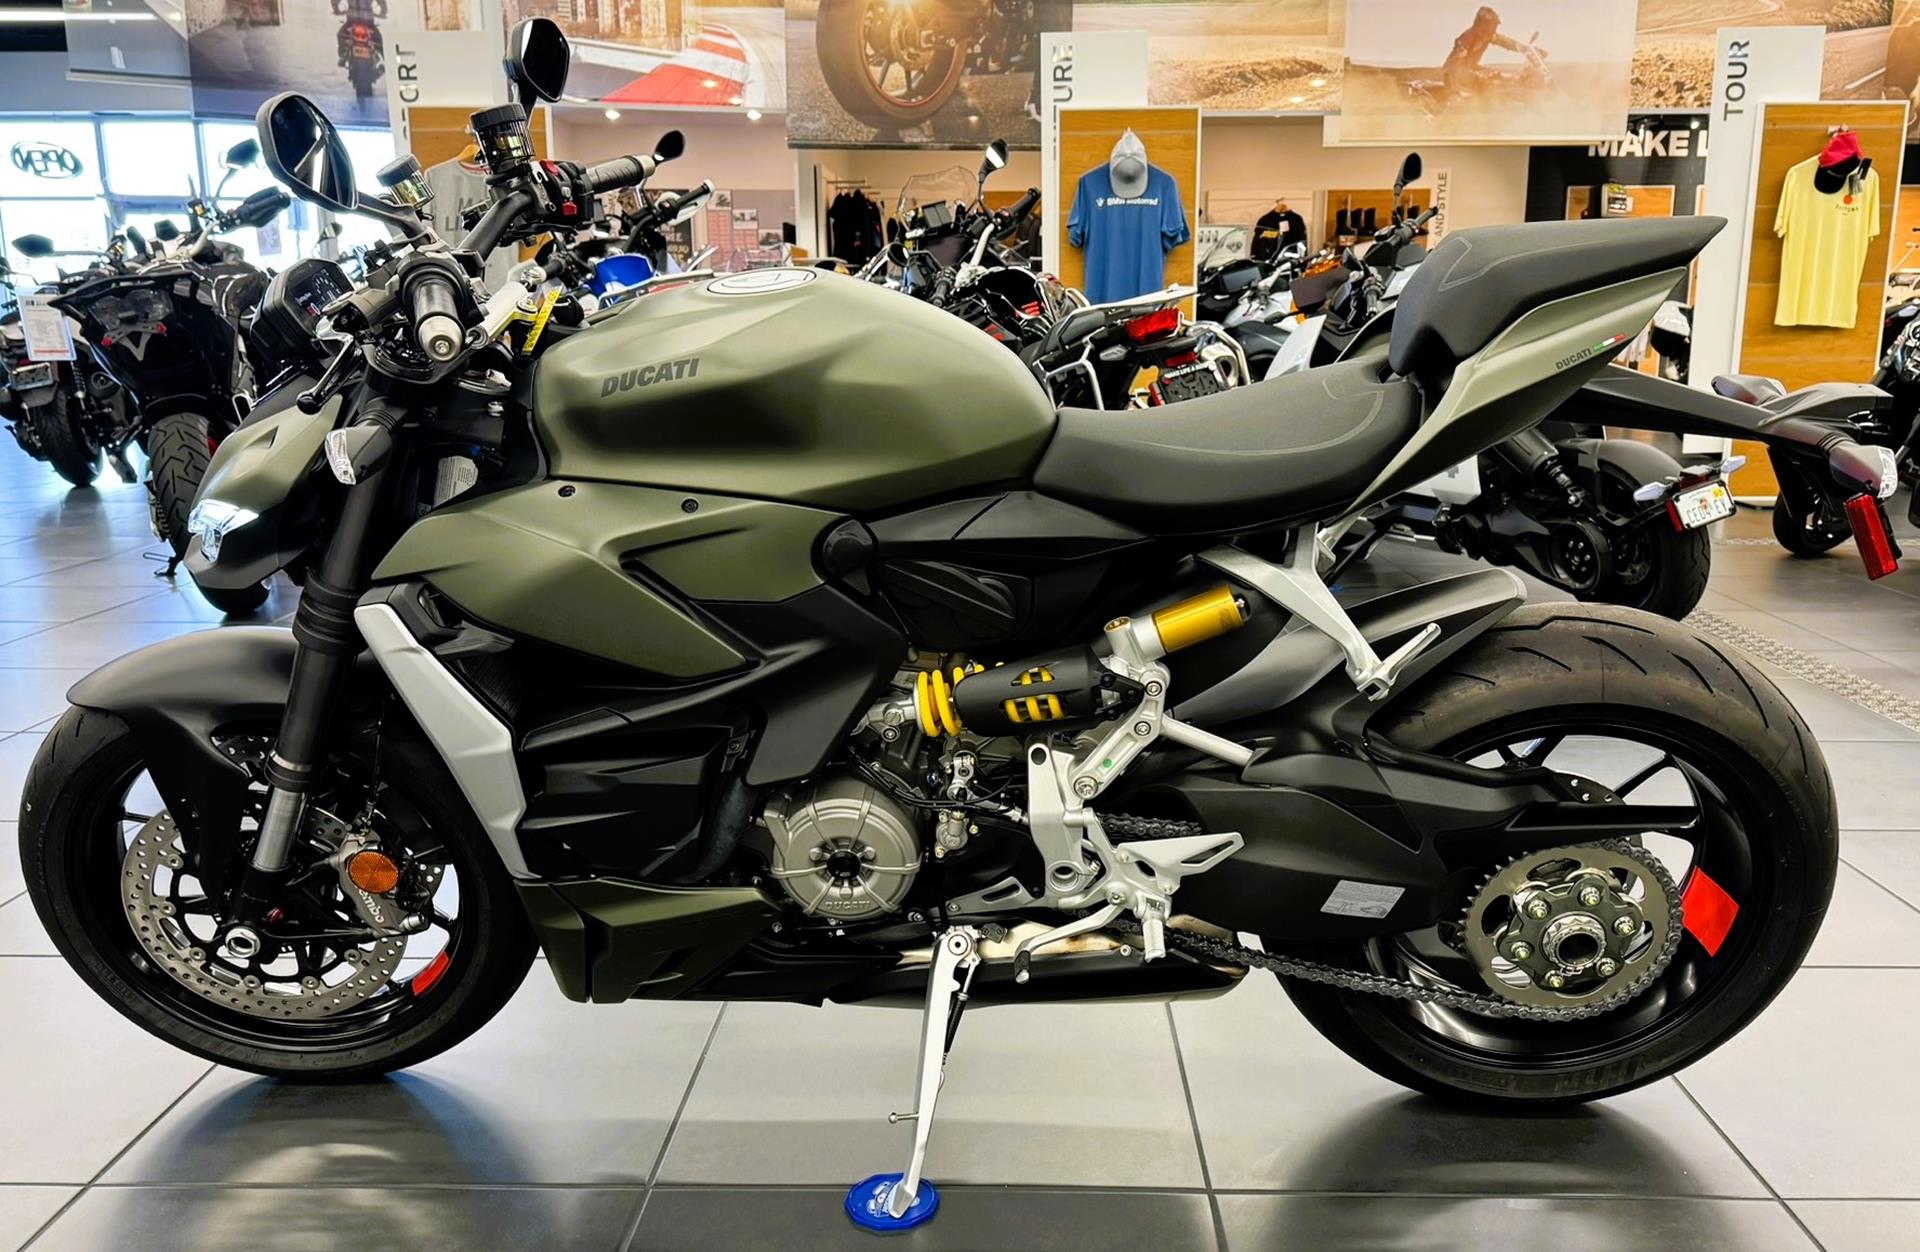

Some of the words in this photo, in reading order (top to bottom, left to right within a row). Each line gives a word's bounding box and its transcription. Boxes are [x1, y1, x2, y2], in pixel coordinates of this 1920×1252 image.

[1724, 40, 1750, 121] TOUR
[1587, 129, 1690, 157] MAKE
[1437, 172, 1447, 210] STYLE
[1555, 348, 1592, 370] DUCATI
[601, 358, 700, 398] DUCATI
[825, 900, 870, 910] DUCATI
